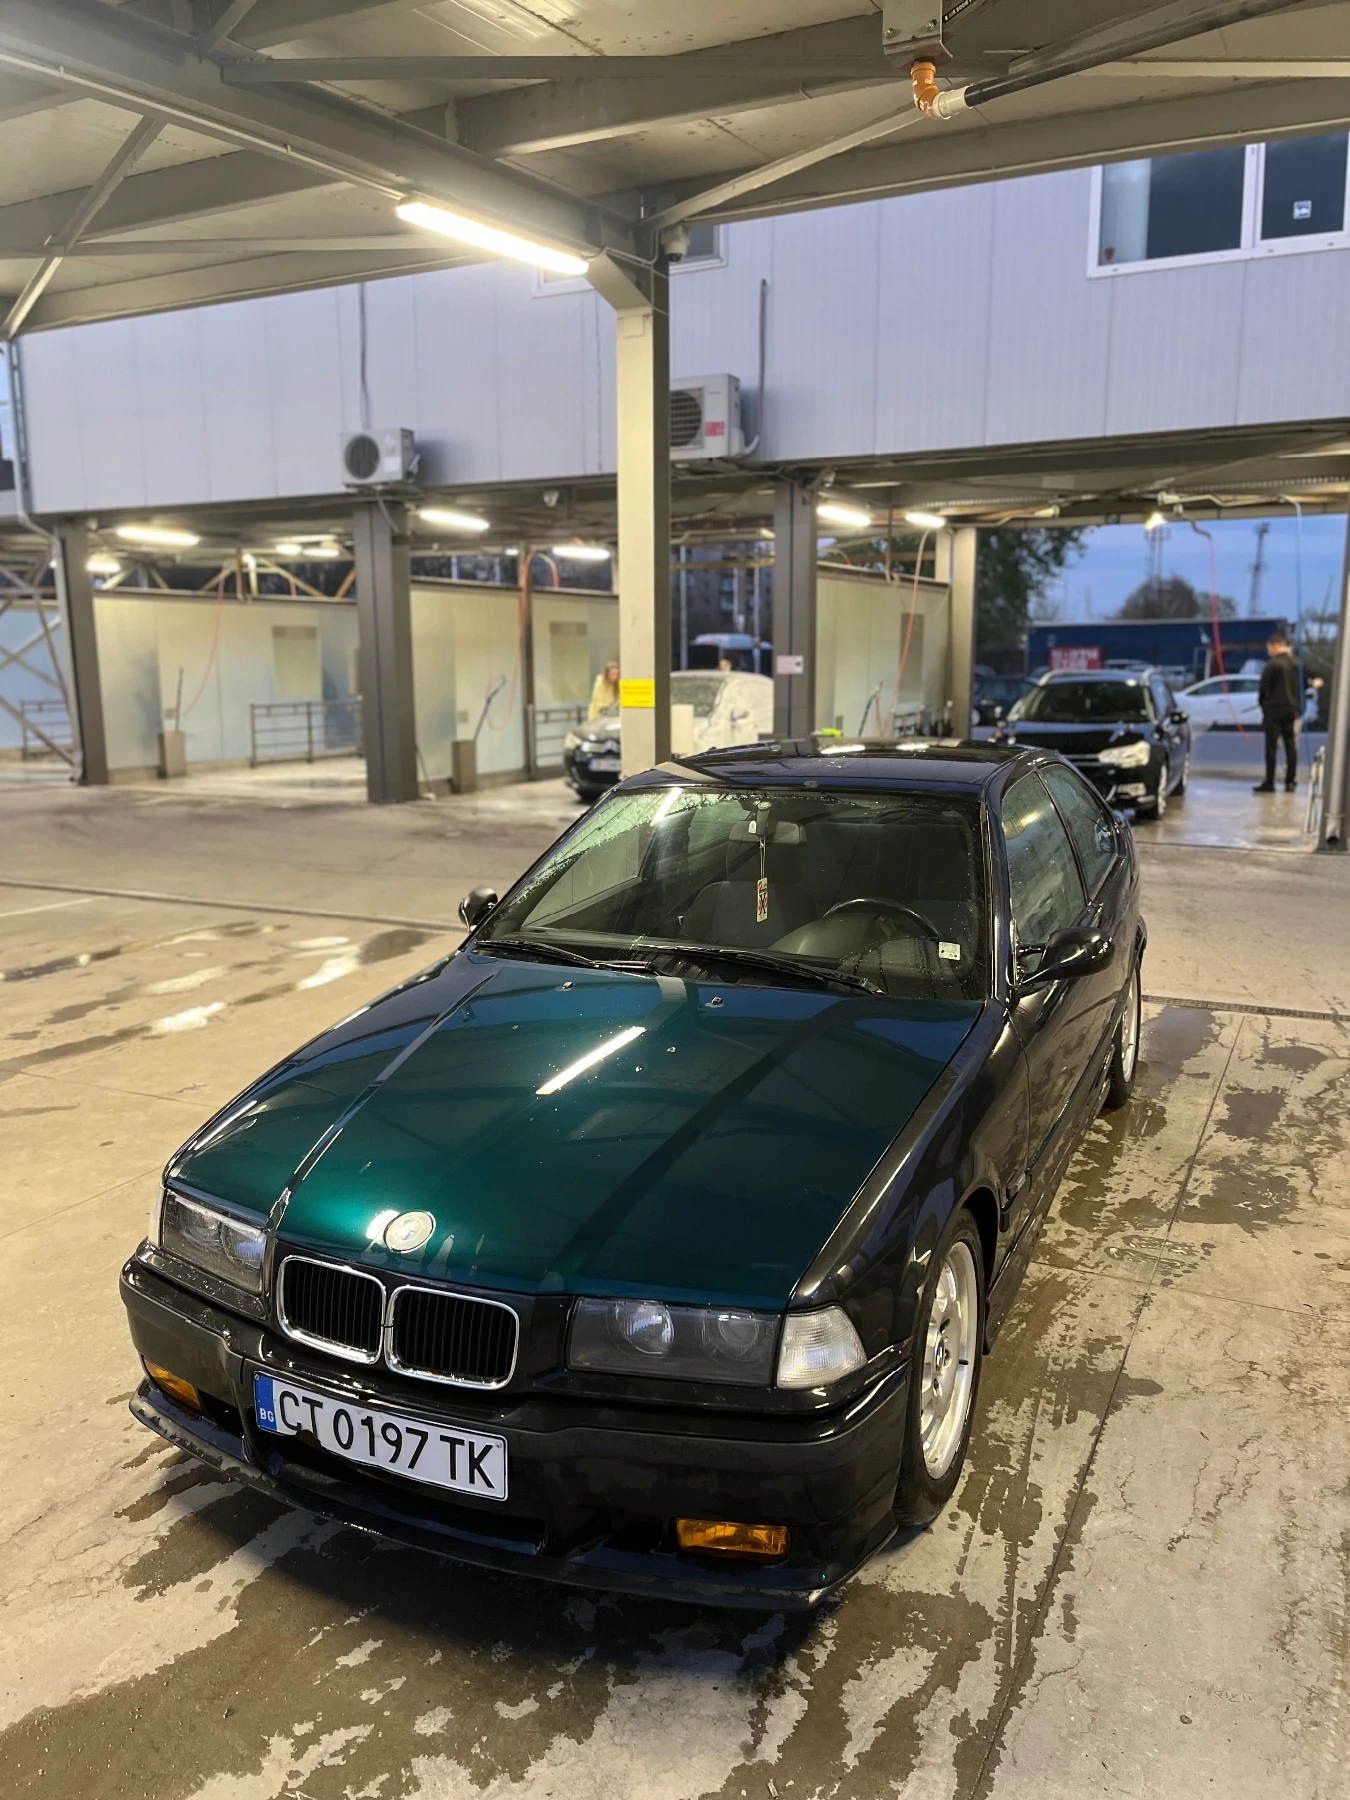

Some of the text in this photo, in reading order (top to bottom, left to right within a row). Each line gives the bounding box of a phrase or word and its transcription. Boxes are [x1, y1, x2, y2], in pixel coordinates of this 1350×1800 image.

[260, 1407, 275, 1422] BG
[279, 1390, 495, 1489] CT 0197 TK
